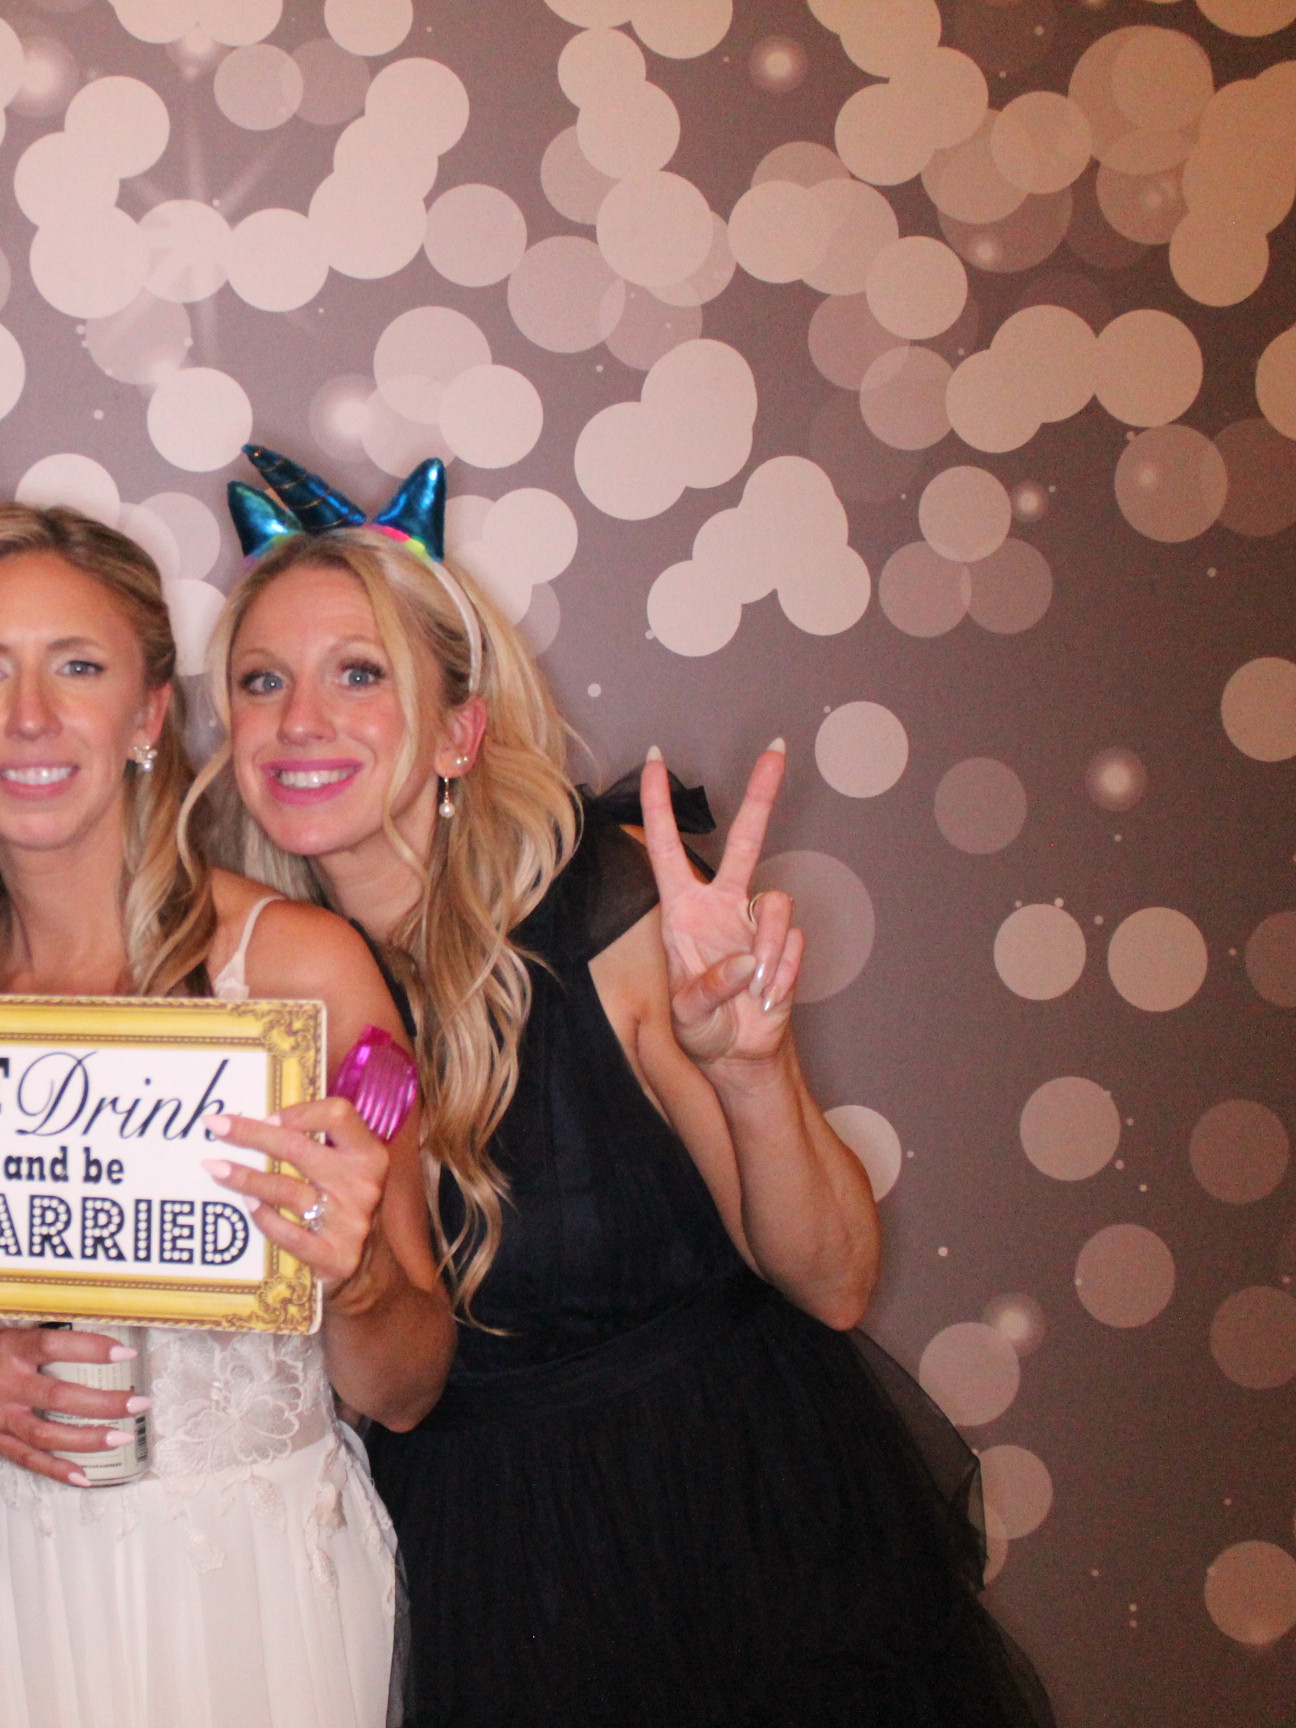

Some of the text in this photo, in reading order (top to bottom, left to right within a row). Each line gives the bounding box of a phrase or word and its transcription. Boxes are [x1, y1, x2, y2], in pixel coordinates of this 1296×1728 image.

[15, 1050, 242, 1141] Drink
[4, 1146, 125, 1185] and be
